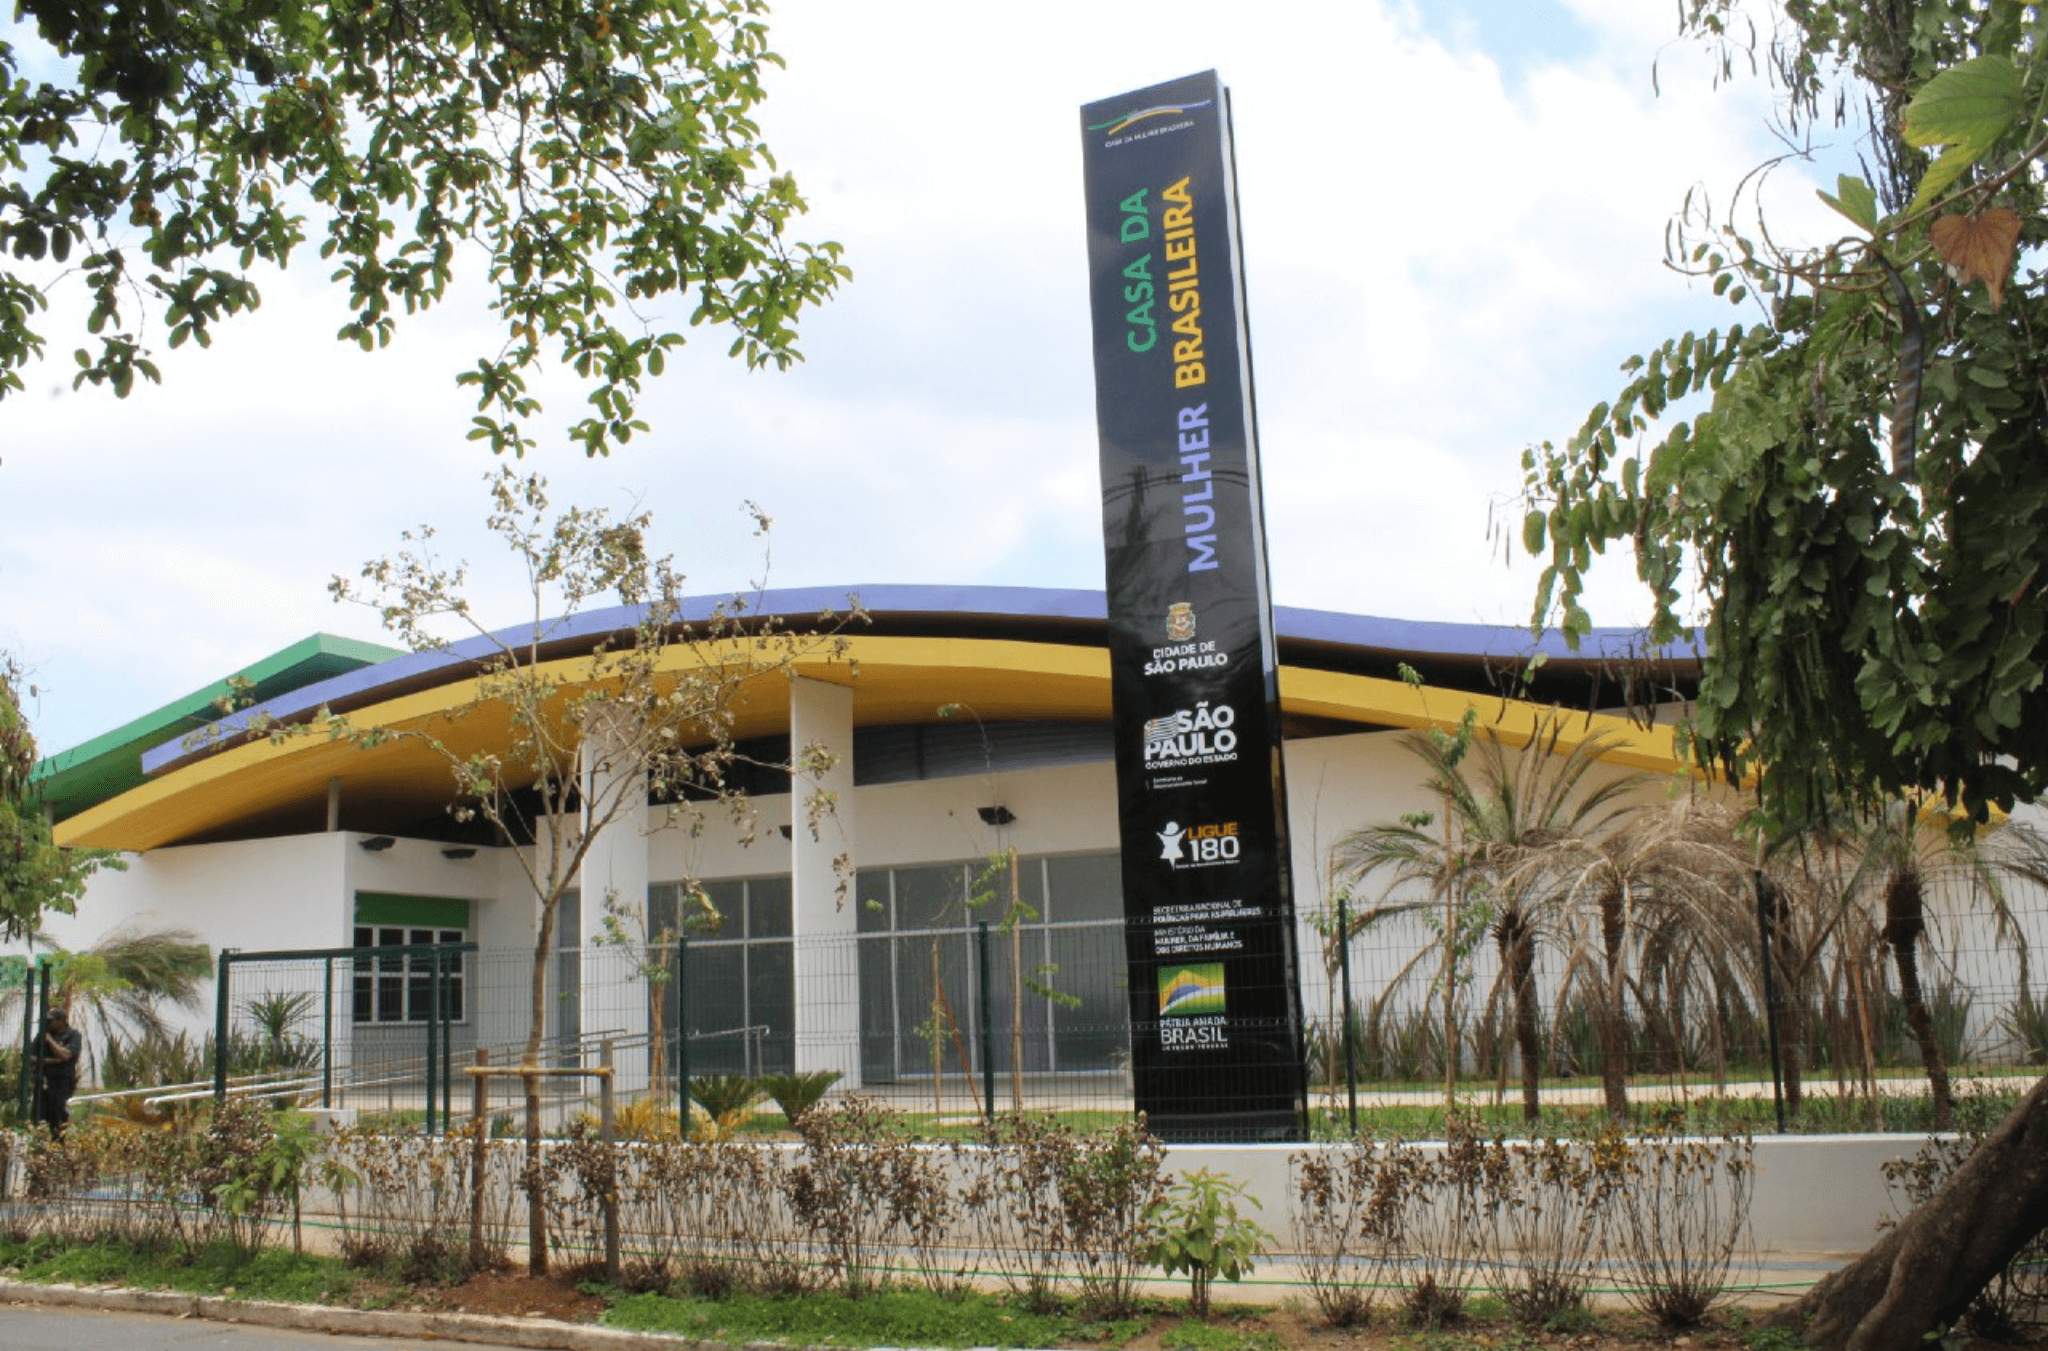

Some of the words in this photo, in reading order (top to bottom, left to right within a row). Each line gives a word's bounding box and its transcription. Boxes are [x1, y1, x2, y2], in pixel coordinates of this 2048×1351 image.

[1119, 187, 1150, 244] DA
[1162, 176, 1206, 389] BRASILEIRA
[1123, 253, 1158, 352] CASA
[1178, 402, 1219, 573] MULHER
[1153, 643, 1196, 659] CIDADE
[1199, 640, 1215, 653] DE
[1144, 659, 1176, 676] SÃO
[1178, 652, 1228, 671] PAULO
[1177, 700, 1235, 733] SÃO
[1144, 729, 1237, 761] PAULO
[1145, 757, 1187, 770] GOVERNO
[1188, 756, 1202, 765] DO
[1203, 752, 1238, 764] ESTADO
[1187, 821, 1238, 839] LIGUE
[1189, 835, 1240, 862] 180
[1193, 1016, 1226, 1026] AMADA
[1160, 1026, 1228, 1045] BRASIL
